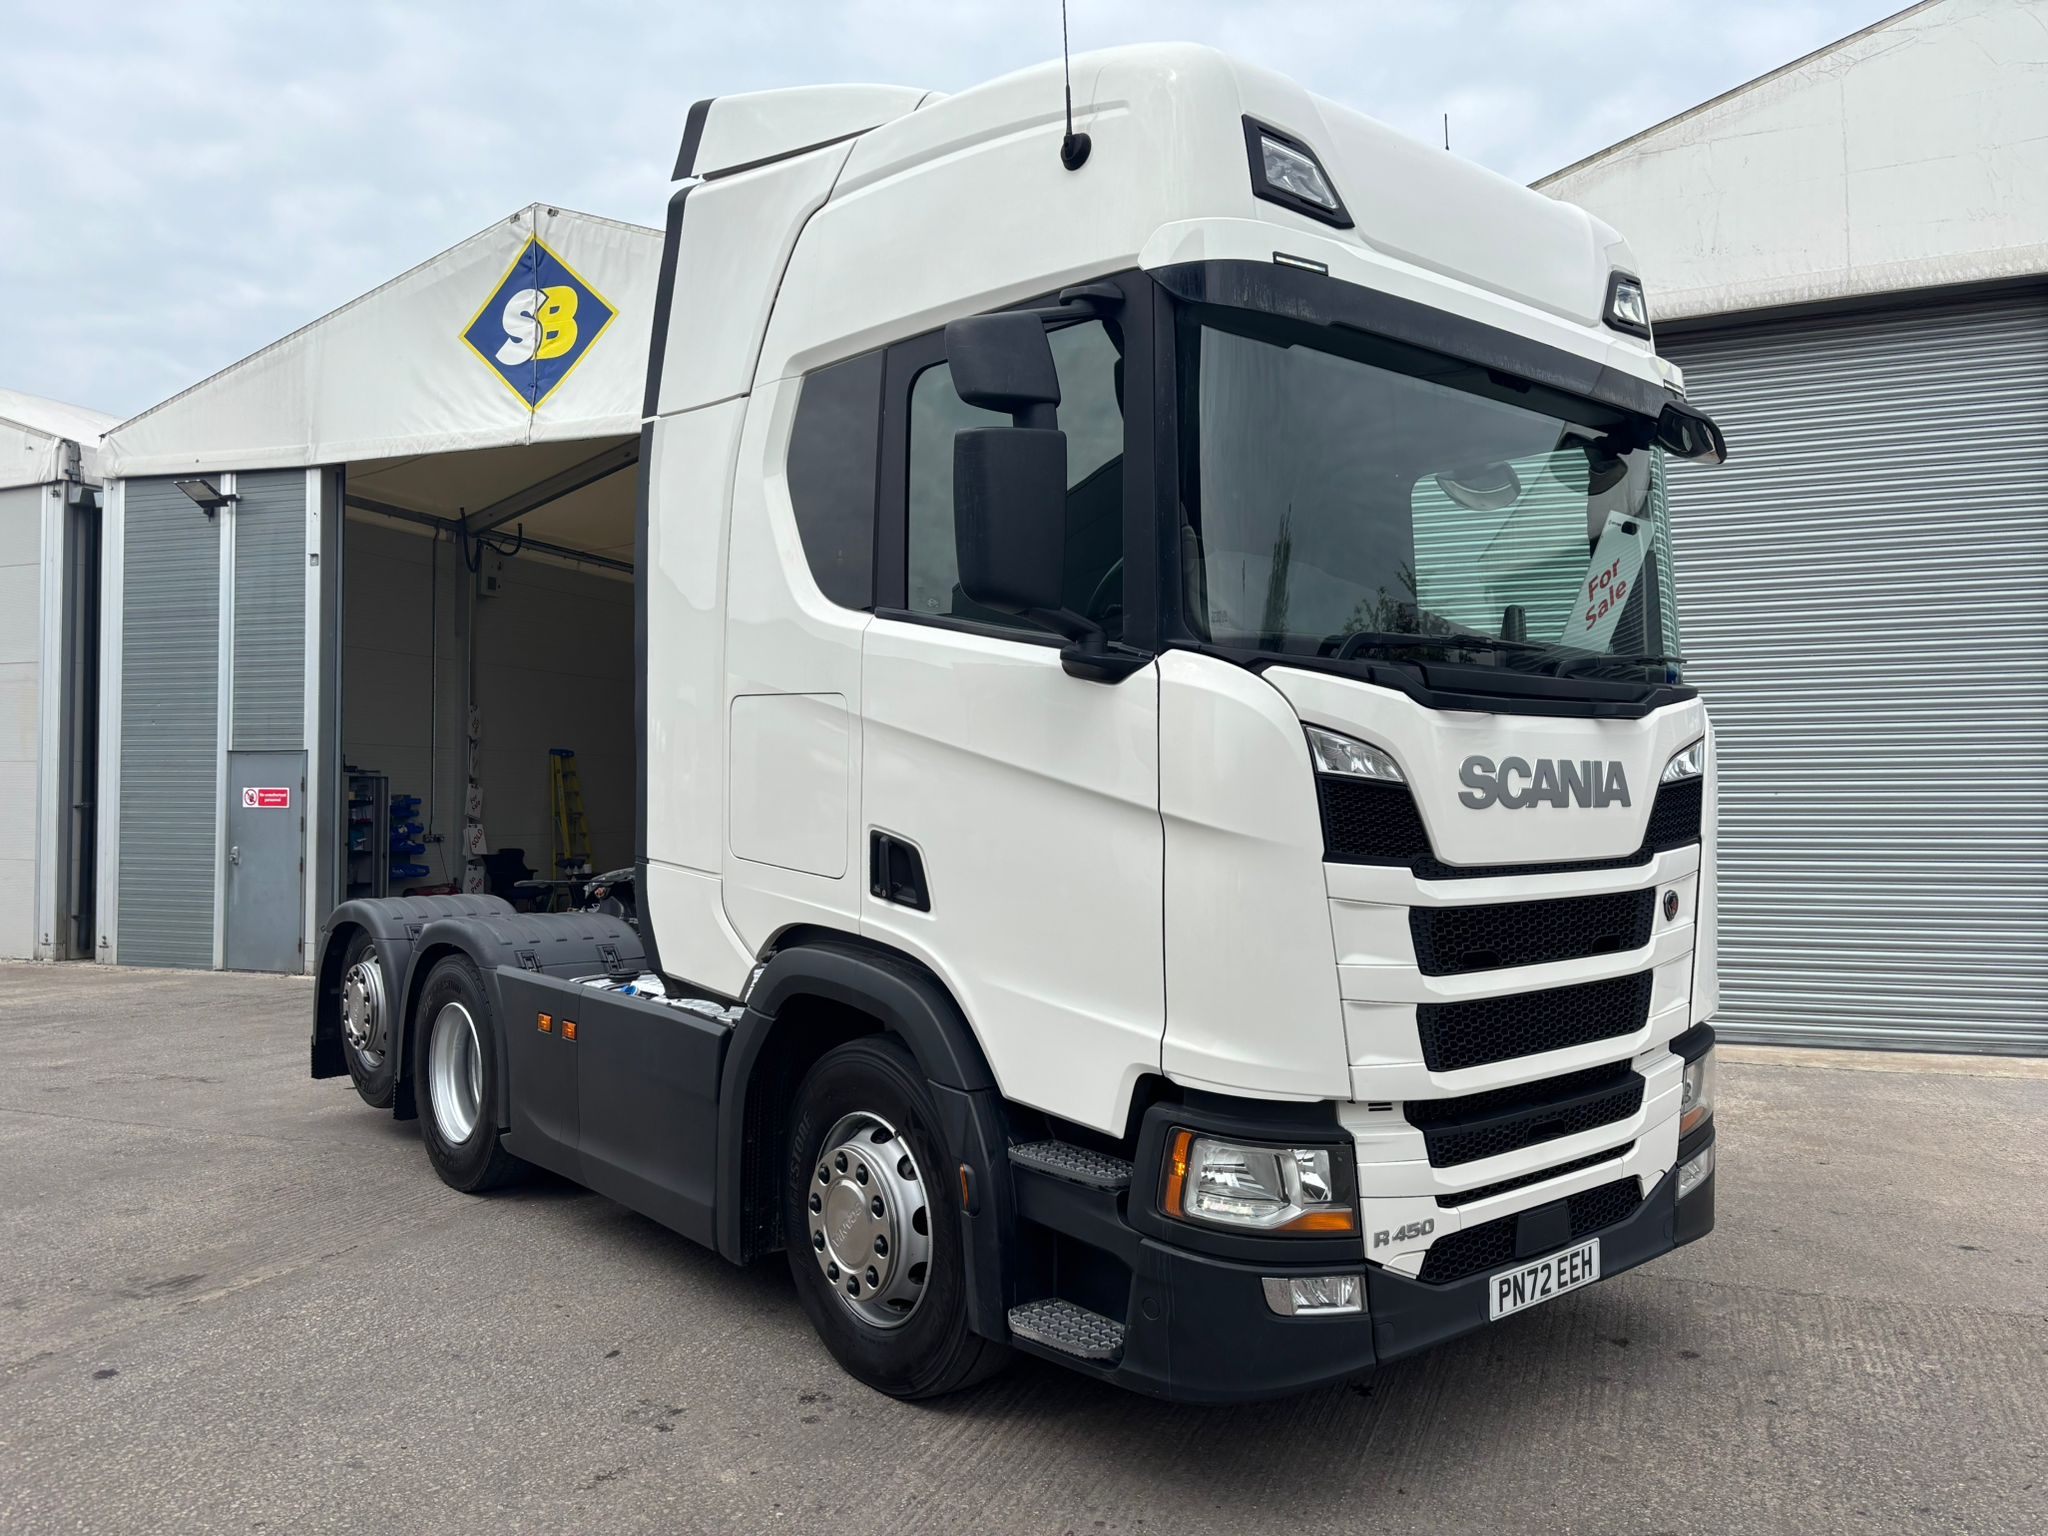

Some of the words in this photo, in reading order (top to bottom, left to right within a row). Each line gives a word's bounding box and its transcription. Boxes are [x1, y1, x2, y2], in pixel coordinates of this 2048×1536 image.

[495, 285, 579, 366] SB
[1585, 580, 1627, 631] Sale
[1588, 558, 1620, 602] For
[1458, 755, 1632, 810] SCANIA
[471, 828, 484, 849] SOLD
[1373, 1230, 1390, 1249] R
[1391, 1218, 1436, 1242] 450
[1499, 1263, 1552, 1312] PN72
[1557, 1245, 1593, 1290] EEH
